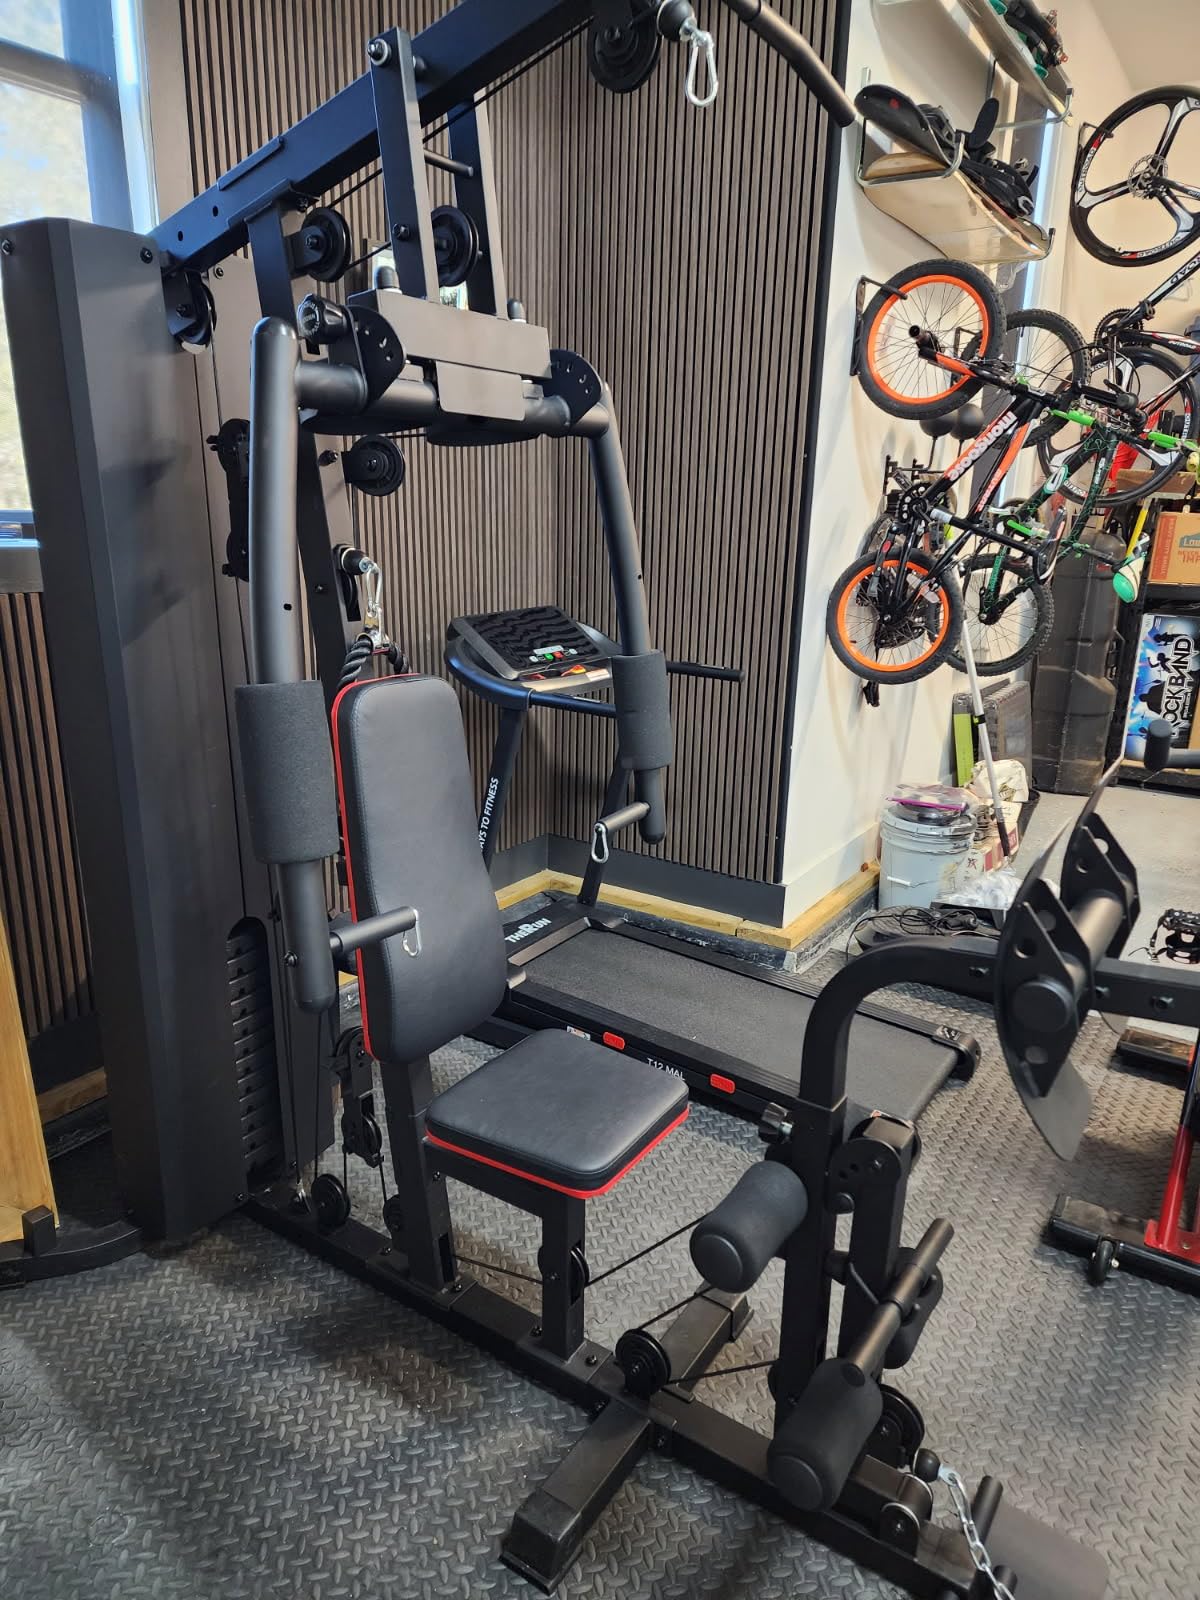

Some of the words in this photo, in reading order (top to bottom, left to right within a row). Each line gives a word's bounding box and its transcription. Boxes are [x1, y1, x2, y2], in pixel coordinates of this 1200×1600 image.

[1167, 637, 1193, 687] BAND
[484, 777, 499, 816] FITNESS
[480, 816, 490, 830] TO
[478, 829, 487, 851] AYS
[647, 1057, 663, 1070] T12
